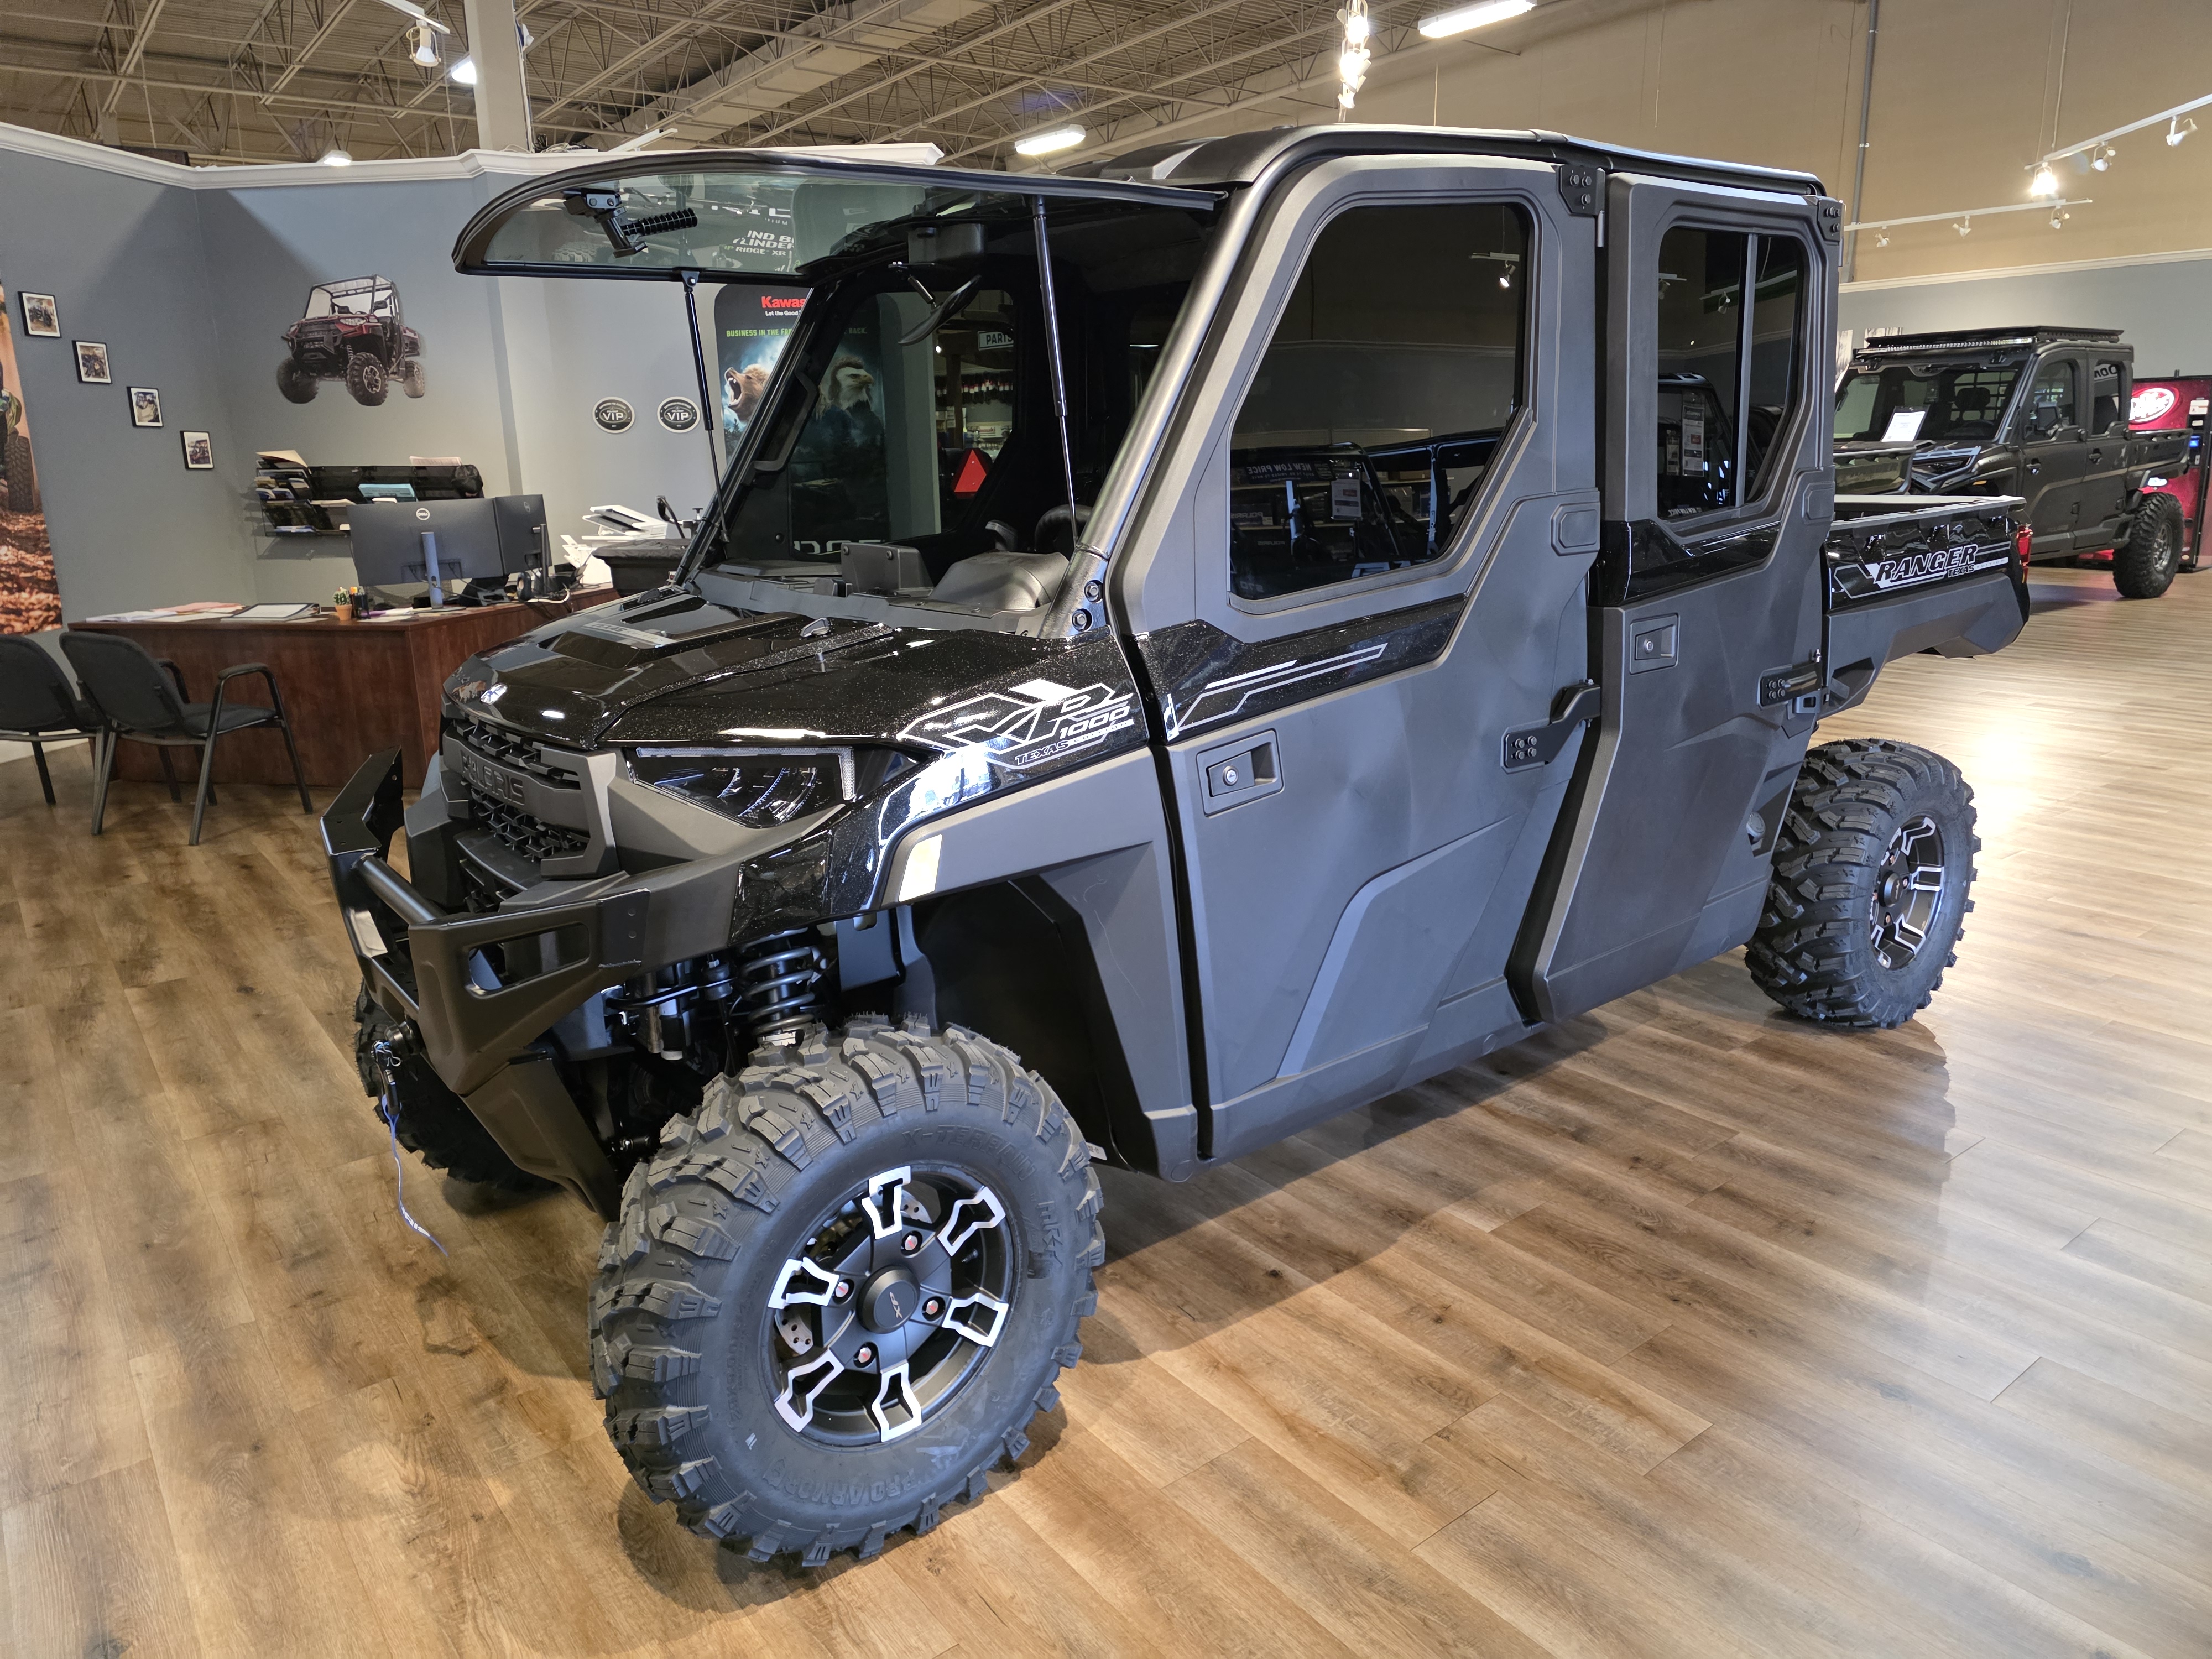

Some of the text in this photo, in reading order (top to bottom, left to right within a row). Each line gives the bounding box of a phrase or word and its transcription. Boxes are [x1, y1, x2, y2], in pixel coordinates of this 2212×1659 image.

[761, 296, 806, 308] Kawas
[602, 412, 624, 420] VIP
[667, 412, 689, 420] VIP
[1873, 544, 1979, 584] RANGER
[1947, 565, 1975, 578] TEXAS
[1059, 705, 1130, 739] 1000
[1015, 722, 1128, 765] TEXAS EDITION
[460, 749, 525, 806] POLARIS
